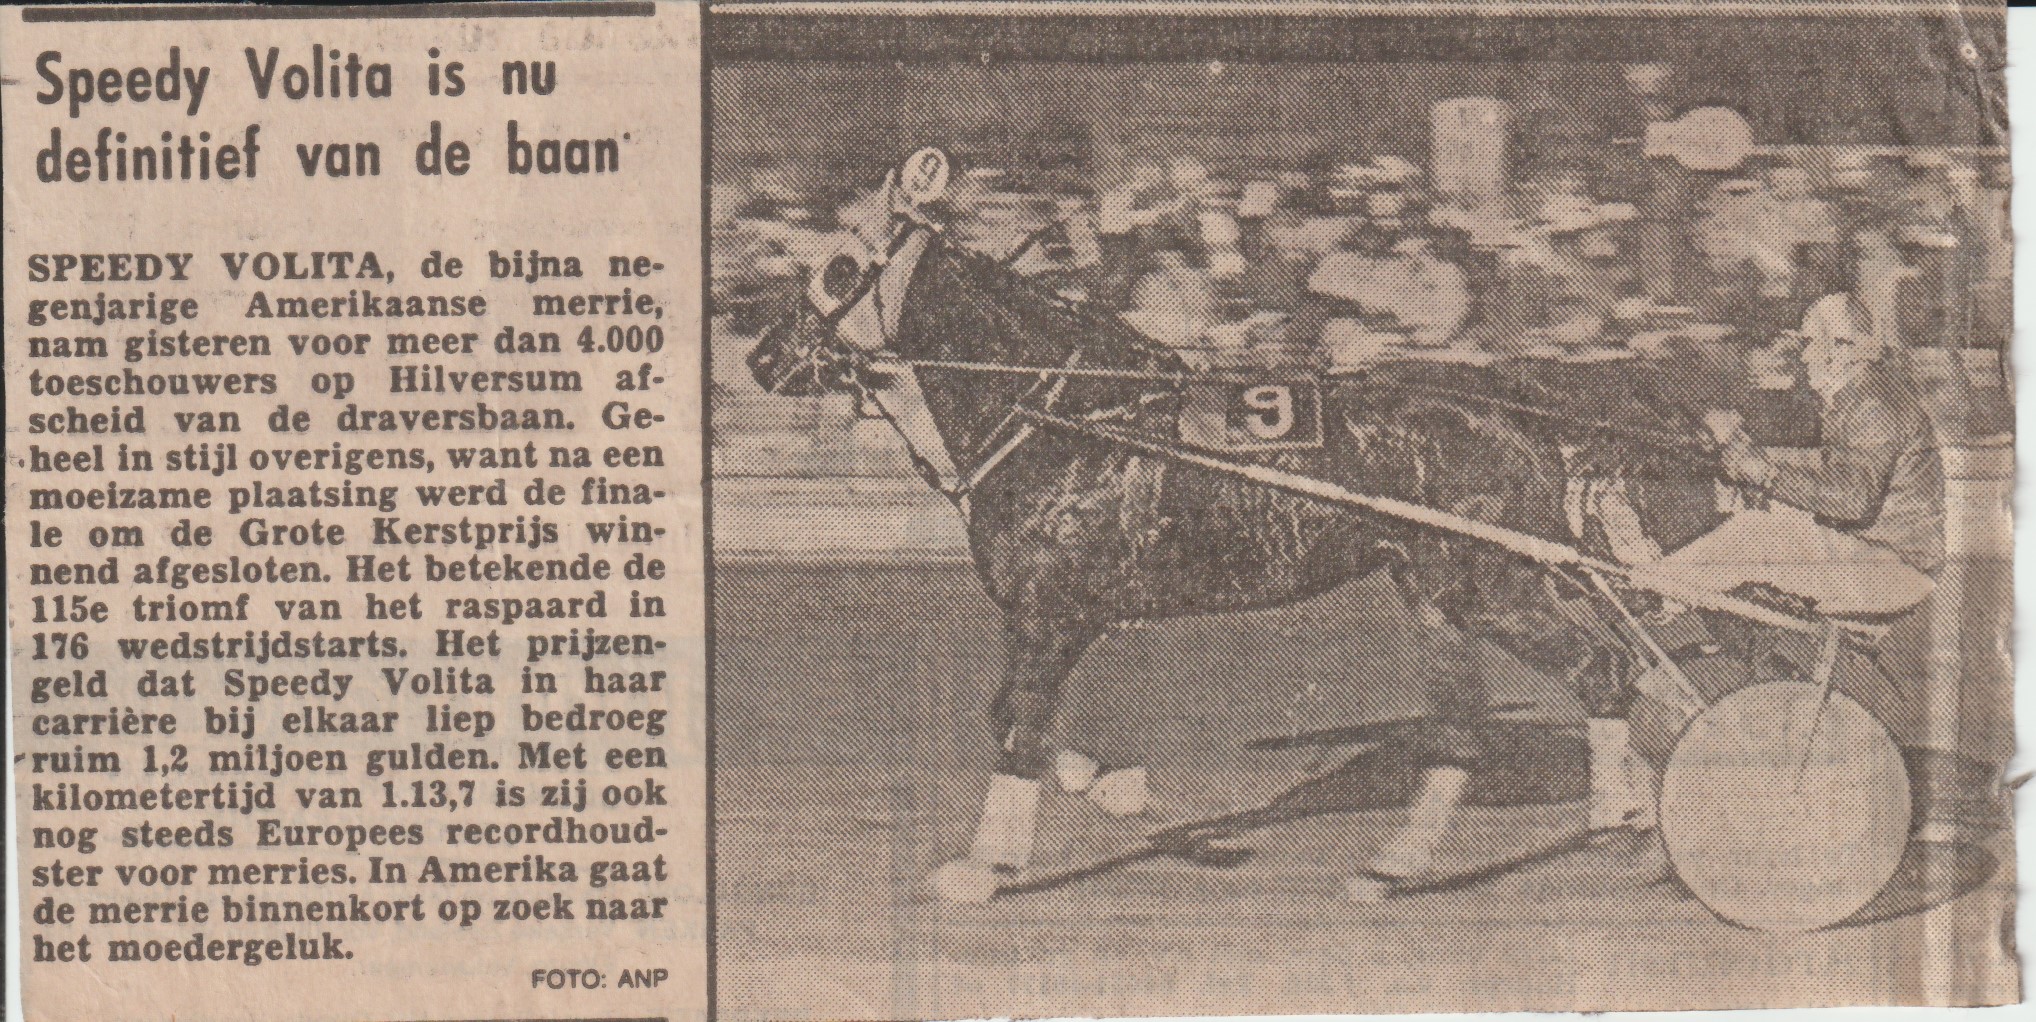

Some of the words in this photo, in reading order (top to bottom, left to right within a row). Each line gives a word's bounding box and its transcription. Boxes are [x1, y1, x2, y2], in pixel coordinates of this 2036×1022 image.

[36, 46, 210, 118] Speedy
[245, 44, 391, 100] Volita
[428, 47, 465, 97] is
[503, 61, 557, 95] nu
[37, 124, 260, 183] definitief
[297, 142, 380, 177] van
[416, 121, 470, 175] de
[507, 120, 618, 174] baan
[28, 253, 193, 282] SPEEDY
[221, 252, 394, 284] VOLITA,
[421, 251, 463, 278] de
[489, 250, 583, 284] bijna
[609, 256, 664, 277] ne-
[28, 292, 198, 326] genjarige
[245, 289, 486, 318] Amerikaanse
[533, 287, 663, 319] merrie,
[29, 337, 108, 358] nam
[125, 329, 271, 362] gisteren
[288, 334, 371, 355] voor
[387, 333, 478, 354] meer
[494, 326, 561, 354] dan
[577, 325, 664, 353] 4.000
[29, 368, 277, 396] toeschouwers
[312, 373, 354, 399] op
[390, 364, 582, 392] Hilversum
[616, 363, 664, 391] af-
[29, 406, 146, 434] scheid
[174, 412, 241, 433] van
[269, 404, 310, 432] de
[337, 403, 574, 431] draversbaan.
[602, 401, 664, 430] Ge-
[1243, 385, 1294, 439] 9
[30, 445, 104, 472] heel
[119, 443, 153, 471] in
[166, 443, 237, 476] stijl
[250, 442, 434, 475] overigens,
[447, 441, 537, 469] want
[549, 447, 592, 468] na
[604, 446, 664, 467] een
[30, 481, 211, 509] moeizame
[229, 480, 398, 514] plaatsing
[416, 479, 507, 506] werd
[524, 478, 565, 505] de
[582, 477, 665, 505] fina-
[30, 520, 62, 547] le
[89, 526, 144, 547] om
[171, 519, 212, 546] de
[240, 518, 344, 546] Grote
[373, 515, 558, 550] Kerstprijs
[586, 515, 665, 543] win-
[30, 557, 119, 585] nend
[134, 556, 330, 589] afgesloten.
[346, 555, 411, 582] Het
[425, 553, 610, 581] betekende
[624, 553, 665, 580] de
[32, 595, 108, 623] 115e
[133, 593, 249, 622] triomf
[275, 600, 341, 620] van
[366, 593, 422, 619] het
[446, 590, 607, 625] raspaard
[630, 590, 666, 617] in
[32, 632, 88, 660] 176
[118, 631, 407, 664] wedstrijdstarts.
[436, 629, 501, 656] Het
[527, 628, 666, 662] prijzen-
[31, 670, 108, 703] geld
[137, 670, 195, 697] dat
[225, 669, 353, 702] Speedy
[381, 667, 495, 695] Volita
[522, 666, 557, 693] in
[585, 666, 666, 693] haar
[33, 707, 176, 735] carrière
[204, 706, 254, 739] bij
[283, 706, 399, 733] elkaar
[426, 704, 495, 737] liep
[521, 703, 667, 736] bedroeg
[32, 745, 121, 773] ruim
[144, 744, 188, 777] 1,2
[209, 744, 347, 777] miljoen
[367, 743, 499, 776] gulden.
[518, 742, 587, 769] Met
[605, 747, 667, 769] een
[33, 782, 275, 815] kilometertijd
[295, 788, 362, 808] van
[383, 780, 475, 812] 1.13,7
[496, 779, 525, 808] is
[541, 778, 586, 812] zij
[603, 778, 667, 806] ook
[33, 827, 98, 854] nog
[122, 820, 233, 847] steeds
[257, 819, 423, 851] Europees
[447, 816, 667, 844] recordhoud-
[33, 860, 103, 887] ster
[115, 865, 197, 886] voor
[208, 857, 356, 885] merries.
[369, 857, 406, 883] In
[418, 855, 578, 883] Amerika
[590, 854, 667, 888] gaat
[33, 897, 74, 924] de
[89, 895, 209, 924] merrie
[222, 894, 425, 922] binnenkort
[438, 900, 481, 927] op
[494, 893, 574, 920] zoek
[586, 897, 668, 920] naar
[33, 934, 91, 962] het
[108, 932, 353, 966] moedergeluk.
[532, 969, 607, 989] FOTO:
[618, 969, 668, 988] ANP
